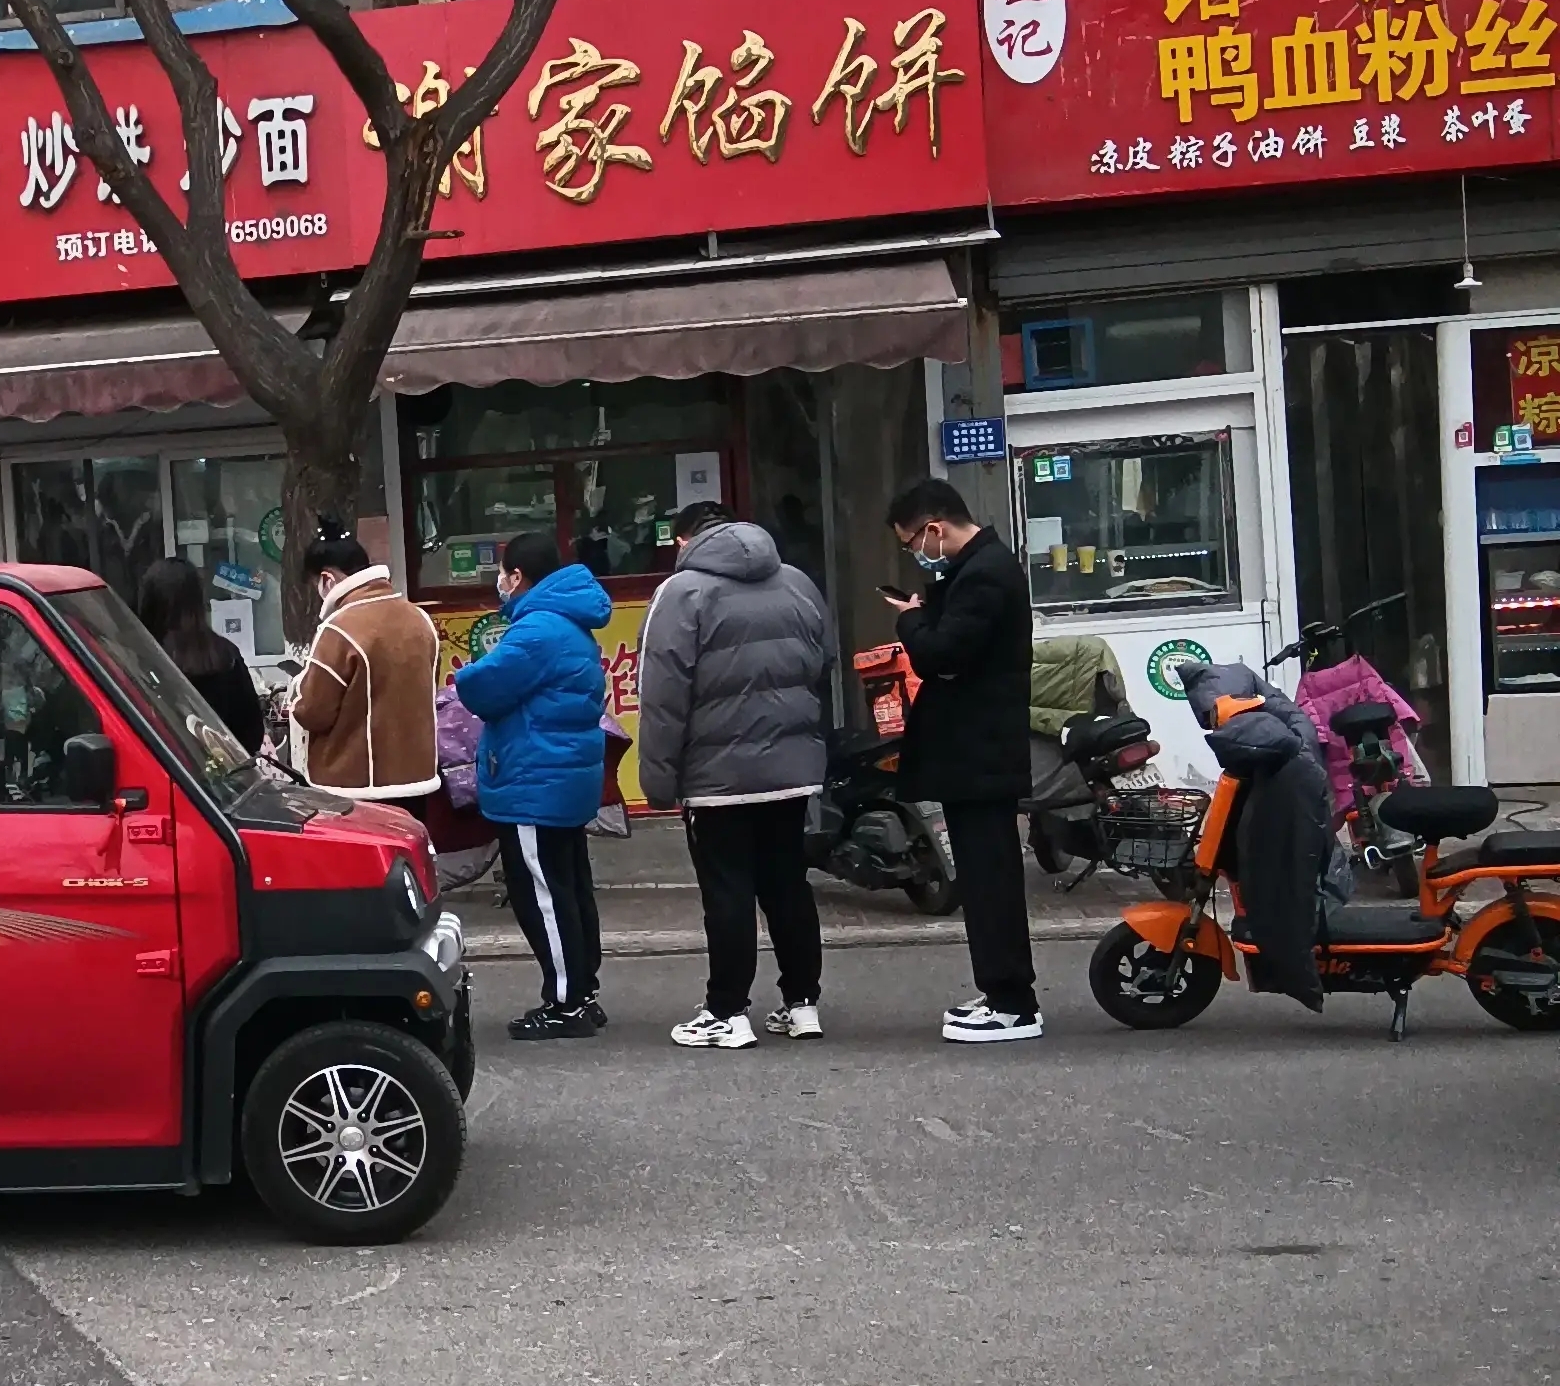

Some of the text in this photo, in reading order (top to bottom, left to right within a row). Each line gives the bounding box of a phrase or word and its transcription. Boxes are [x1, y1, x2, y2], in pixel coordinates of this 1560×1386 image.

[1349, 113, 1407, 150] 豆浆
[1440, 97, 1533, 143] 茶叶蛋
[224, 212, 328, 245] 6509068
